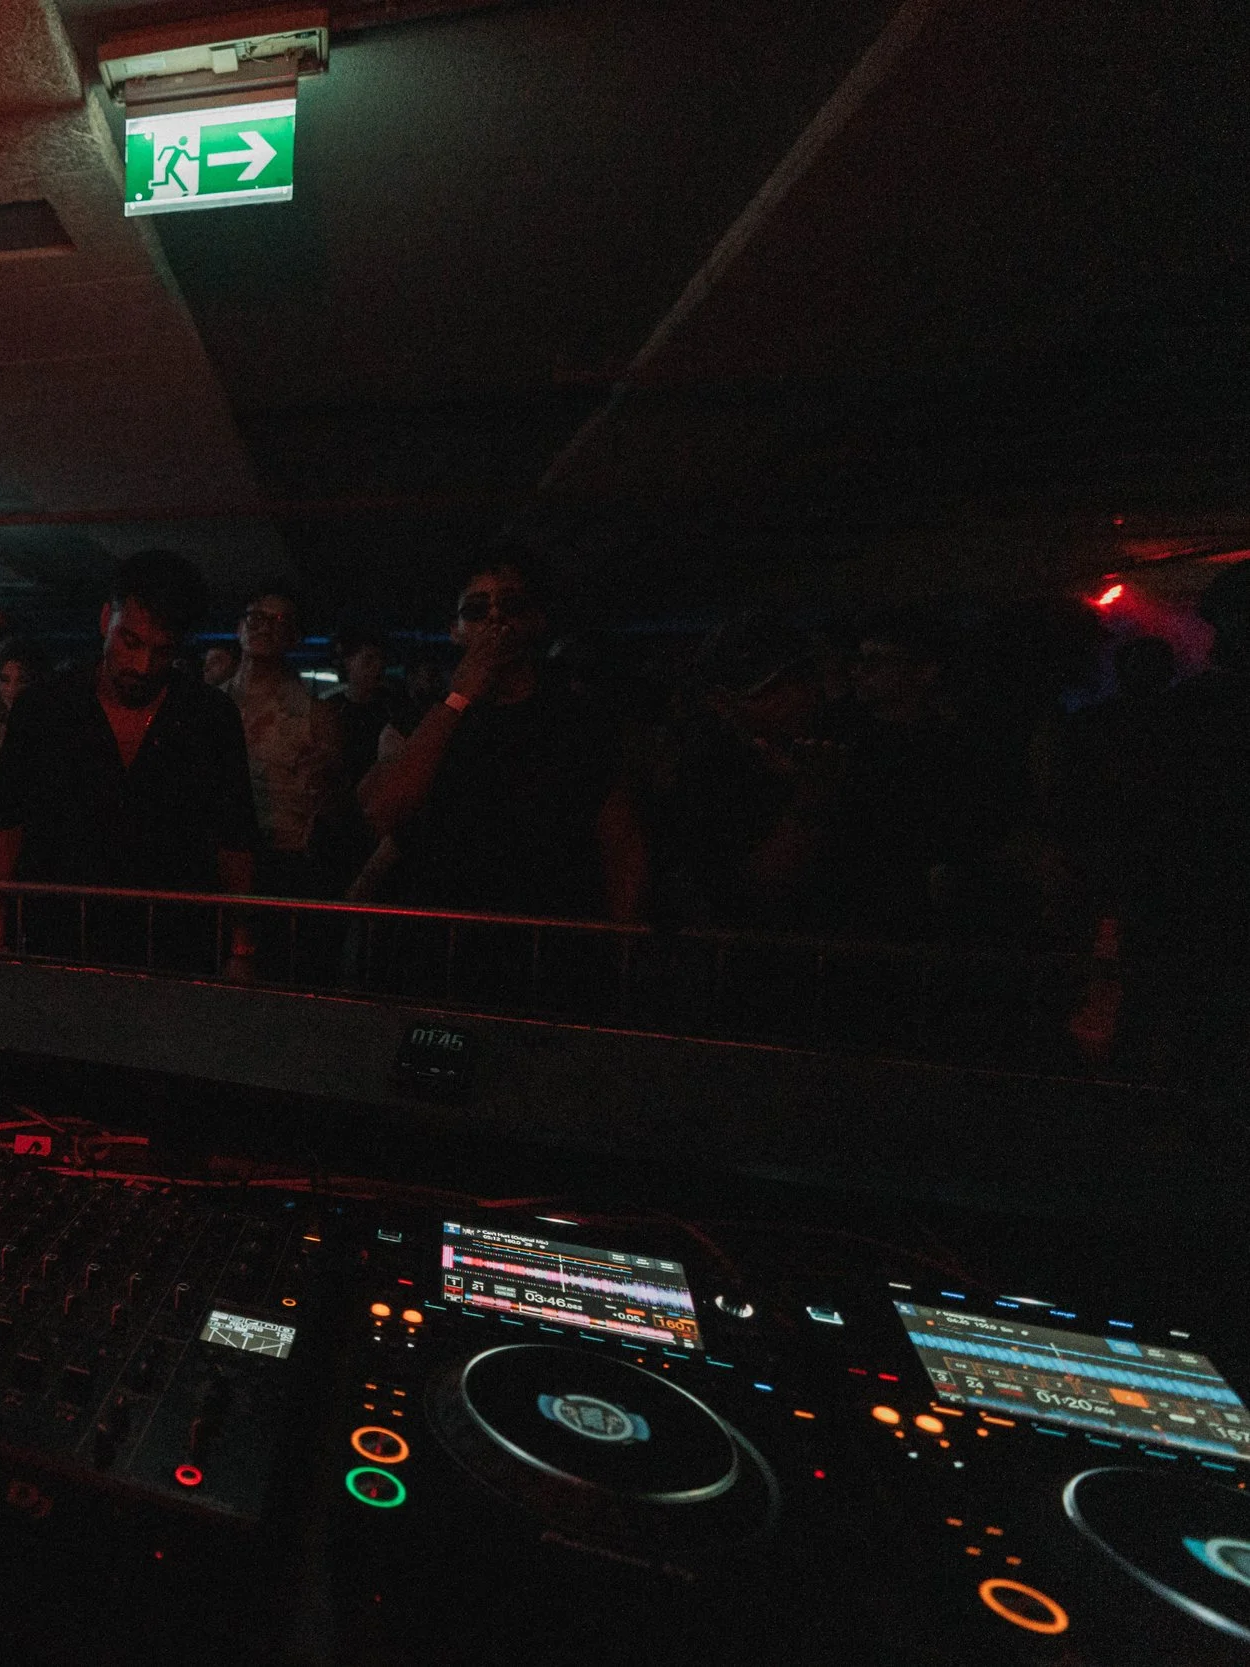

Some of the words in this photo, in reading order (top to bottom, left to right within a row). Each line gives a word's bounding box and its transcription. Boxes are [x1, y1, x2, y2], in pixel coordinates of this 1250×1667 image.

[410, 1028, 465, 1051] 01:45
[472, 1283, 484, 1292] 21
[966, 1379, 985, 1390] 24
